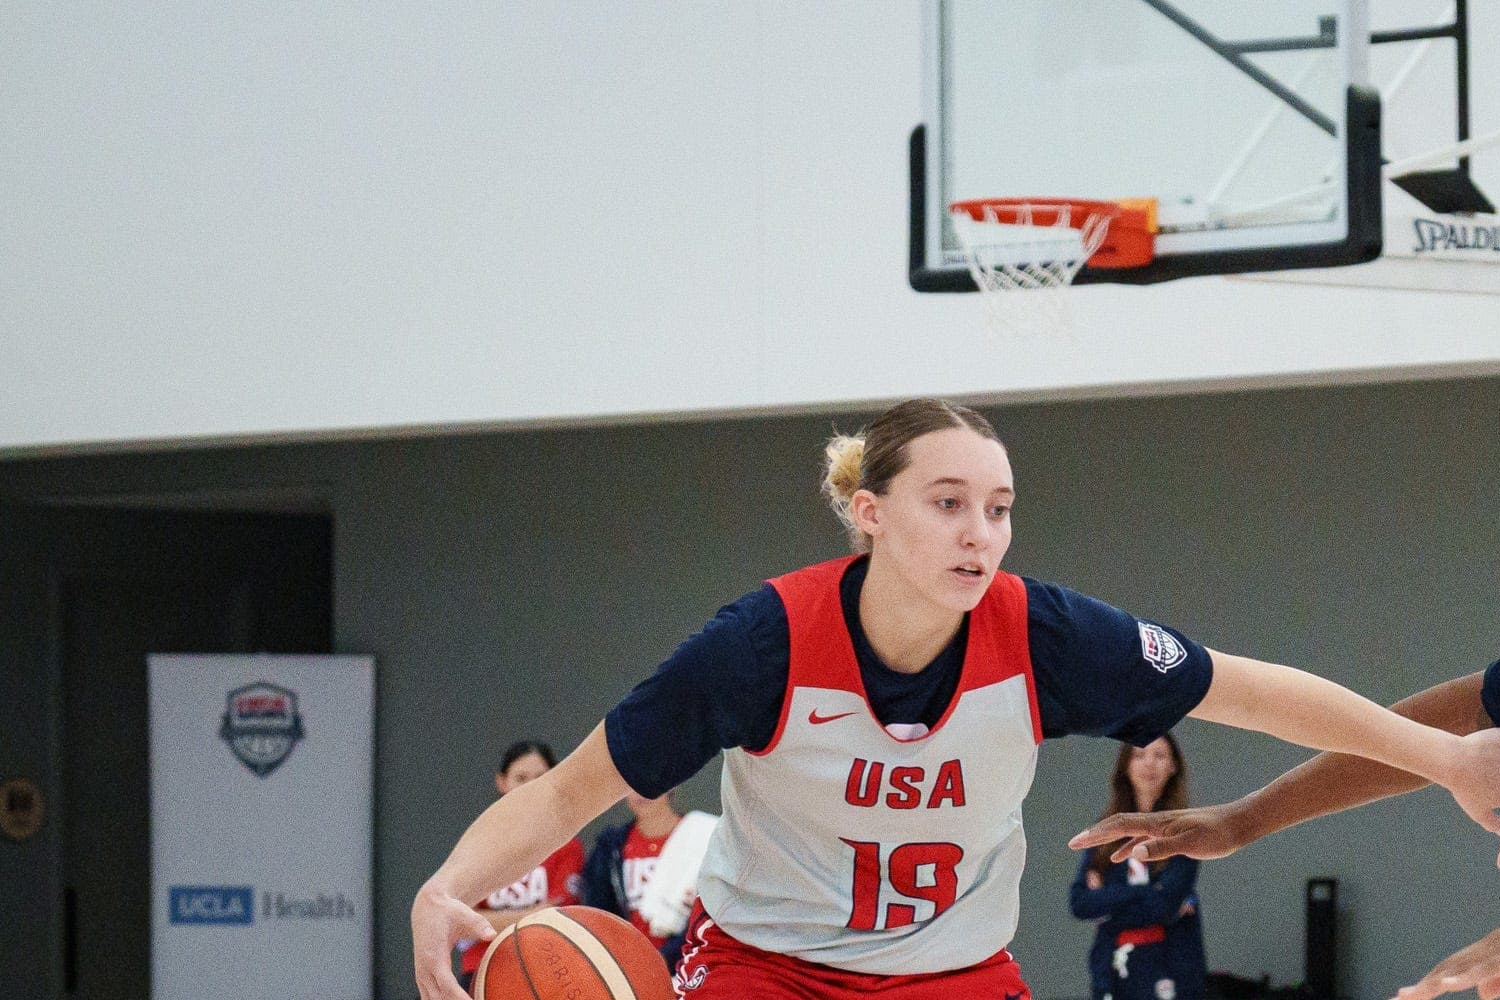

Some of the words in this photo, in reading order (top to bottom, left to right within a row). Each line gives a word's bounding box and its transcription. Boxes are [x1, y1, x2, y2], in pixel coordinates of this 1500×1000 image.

[845, 757, 966, 810] USA
[179, 894, 244, 917] UCLA
[262, 891, 355, 920] Health
[838, 836, 964, 931] 19
